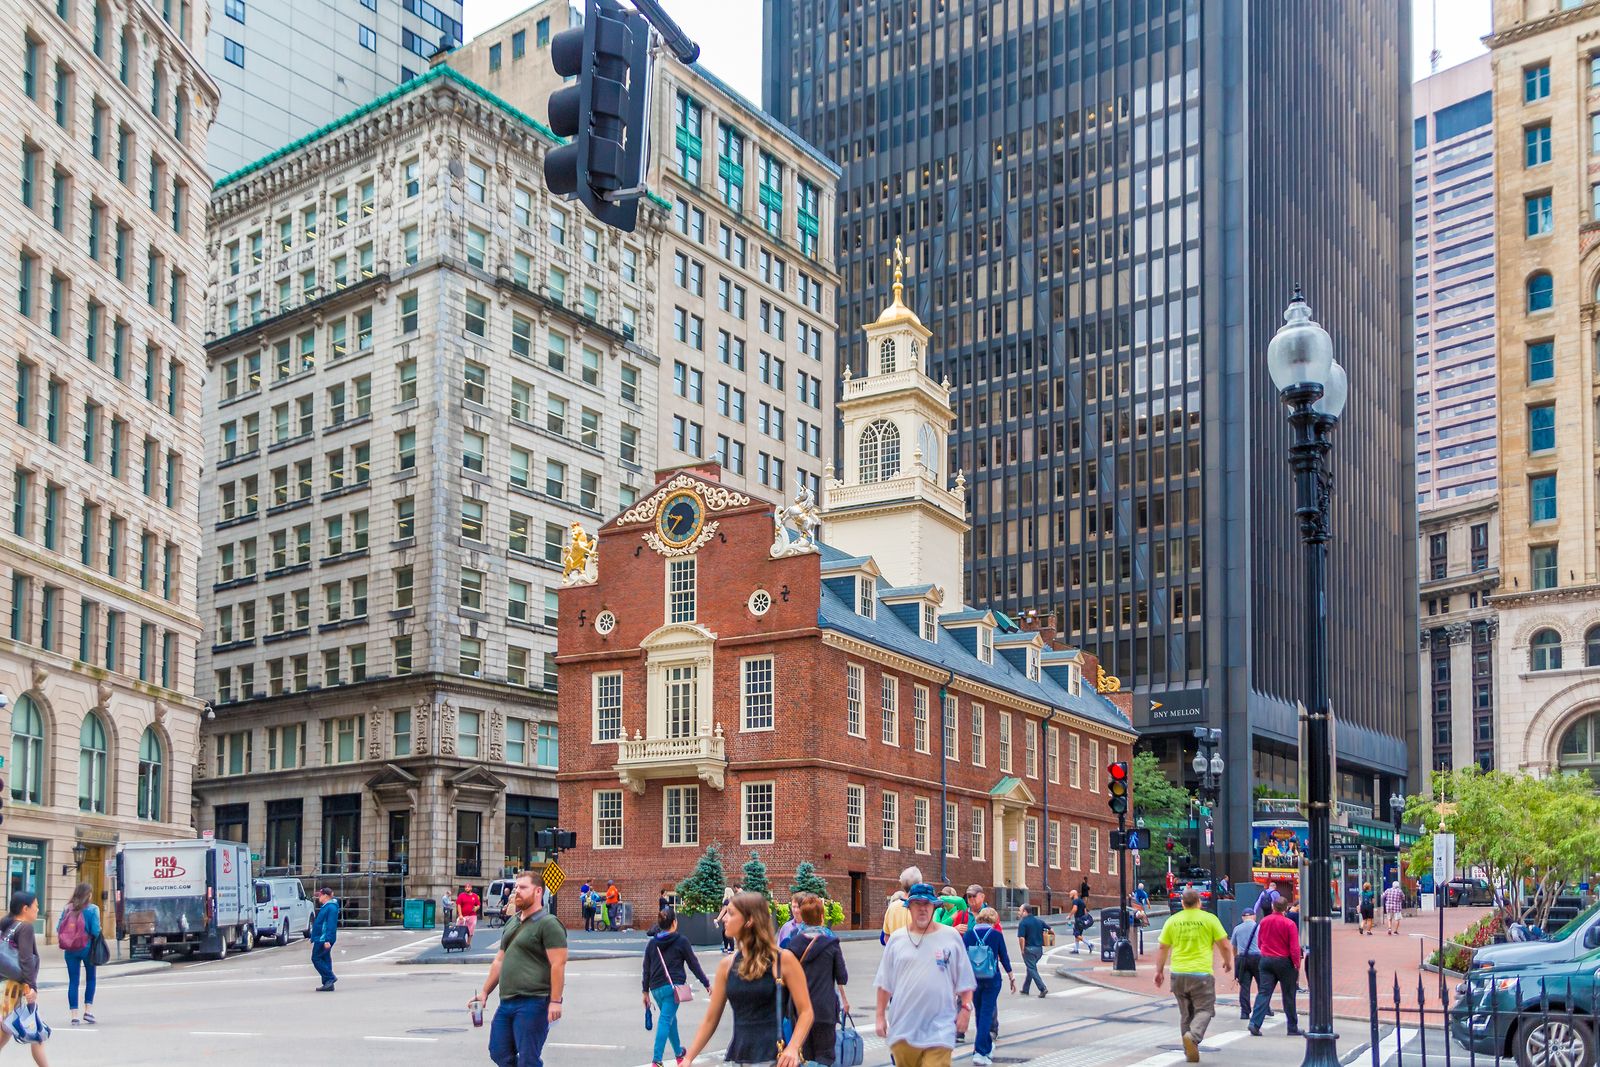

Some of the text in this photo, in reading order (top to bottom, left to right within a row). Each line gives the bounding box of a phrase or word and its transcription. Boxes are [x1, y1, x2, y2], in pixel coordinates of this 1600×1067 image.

[1170, 708, 1200, 717] MELLON
[155, 856, 177, 867] PRO
[153, 868, 175, 878] CUT
